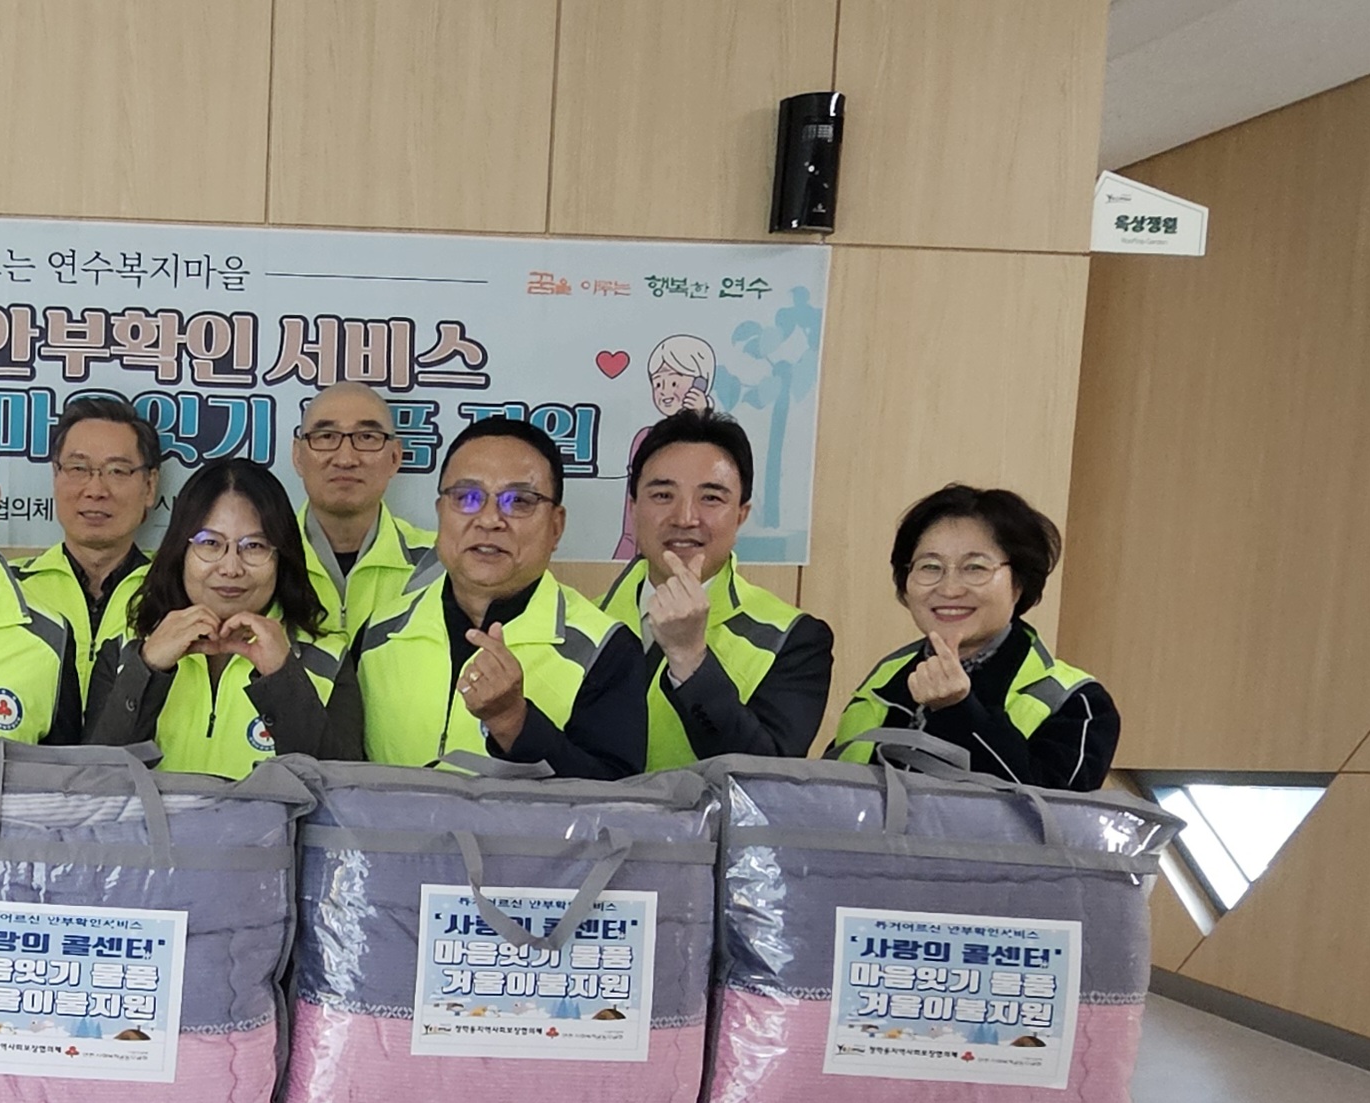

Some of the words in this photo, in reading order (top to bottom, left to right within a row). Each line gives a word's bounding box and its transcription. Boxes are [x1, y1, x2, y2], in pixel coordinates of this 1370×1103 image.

[1115, 215, 1178, 234] 옥상정원
[47, 248, 251, 292] 연수복지마을
[581, 279, 631, 296] 이루는
[644, 275, 710, 299] 행복한
[719, 277, 773, 299] 연수
[265, 315, 491, 390] 서비스
[570, 944, 632, 969] 물품
[91, 962, 159, 990] 물품
[442, 969, 630, 998] 겨울이불지원
[850, 962, 980, 993] 마음잇기
[990, 971, 1057, 998] 물품
[858, 991, 1053, 1026] 겨울이불지원
